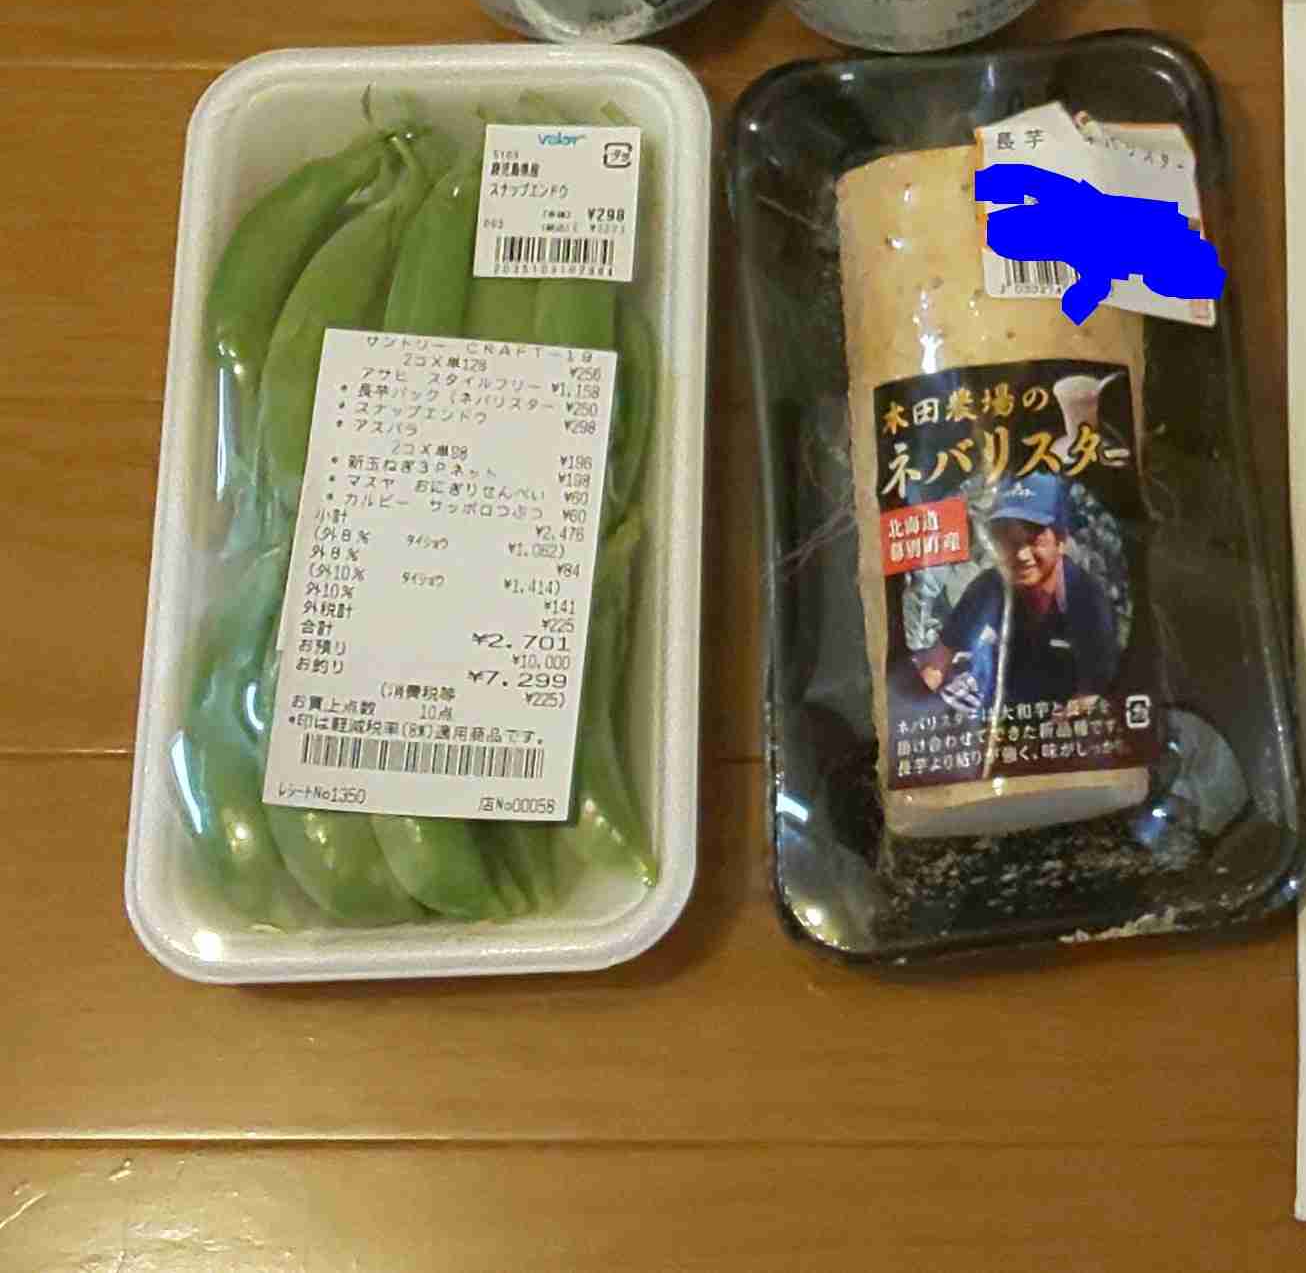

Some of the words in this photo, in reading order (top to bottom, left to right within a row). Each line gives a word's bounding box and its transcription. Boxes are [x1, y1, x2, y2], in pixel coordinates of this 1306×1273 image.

[996, 128, 1047, 151] 長芋
[366, 335, 446, 351] サントリー
[360, 366, 409, 383] アサヒ
[569, 367, 602, 382] ¥256
[565, 402, 599, 418] ¥250
[353, 419, 419, 437] アスパラ
[564, 419, 597, 435] ¥298
[880, 424, 1132, 500] ネバリスター
[347, 474, 396, 489] マスヤ
[563, 490, 590, 506] ¥60
[315, 508, 347, 524] 小計
[344, 492, 409, 509] カルビー
[562, 508, 587, 524] ¥60
[556, 562, 581, 579] ¥84
[303, 600, 353, 619] 外税計
[541, 617, 576, 633] ¥225
[543, 599, 577, 616] ¥141
[300, 619, 333, 636] 合計
[297, 638, 347, 657] お預り
[295, 657, 344, 675] お釣り
[291, 694, 376, 717] お買上点数
[420, 703, 453, 722] 10点
[524, 692, 566, 710] ¥225)
